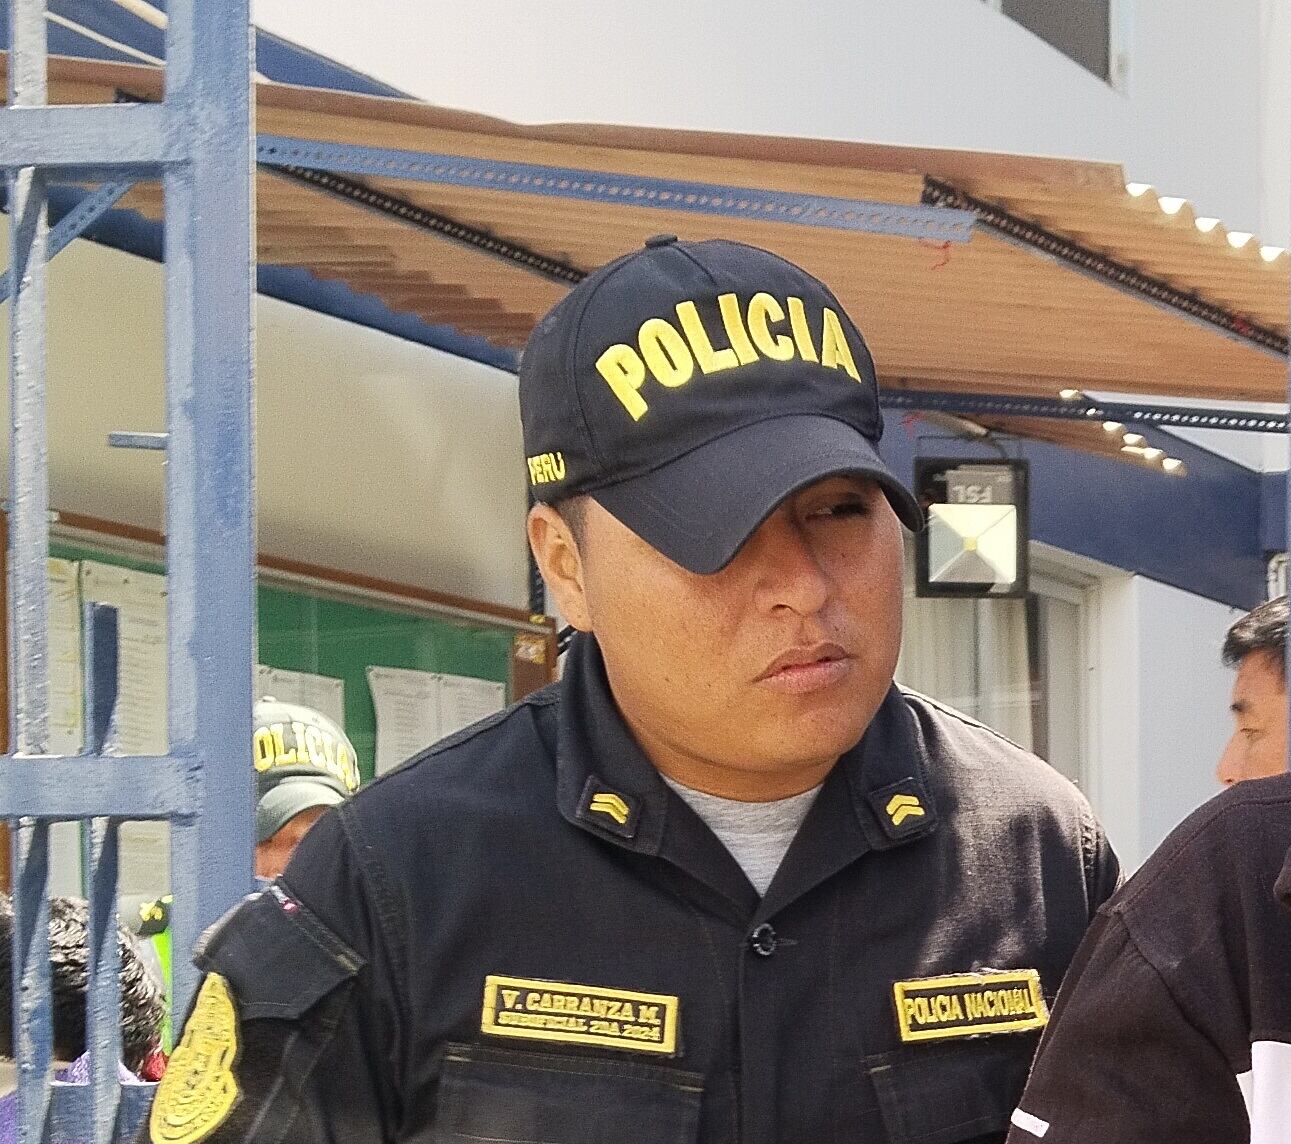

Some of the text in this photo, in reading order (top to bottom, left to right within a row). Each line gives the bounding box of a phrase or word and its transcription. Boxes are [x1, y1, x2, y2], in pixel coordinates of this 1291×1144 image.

[595, 292, 862, 422] POLICIA
[502, 990, 661, 1025] V. CARRANZA M.
[903, 986, 1036, 1025] POLICIA NACIONAL
